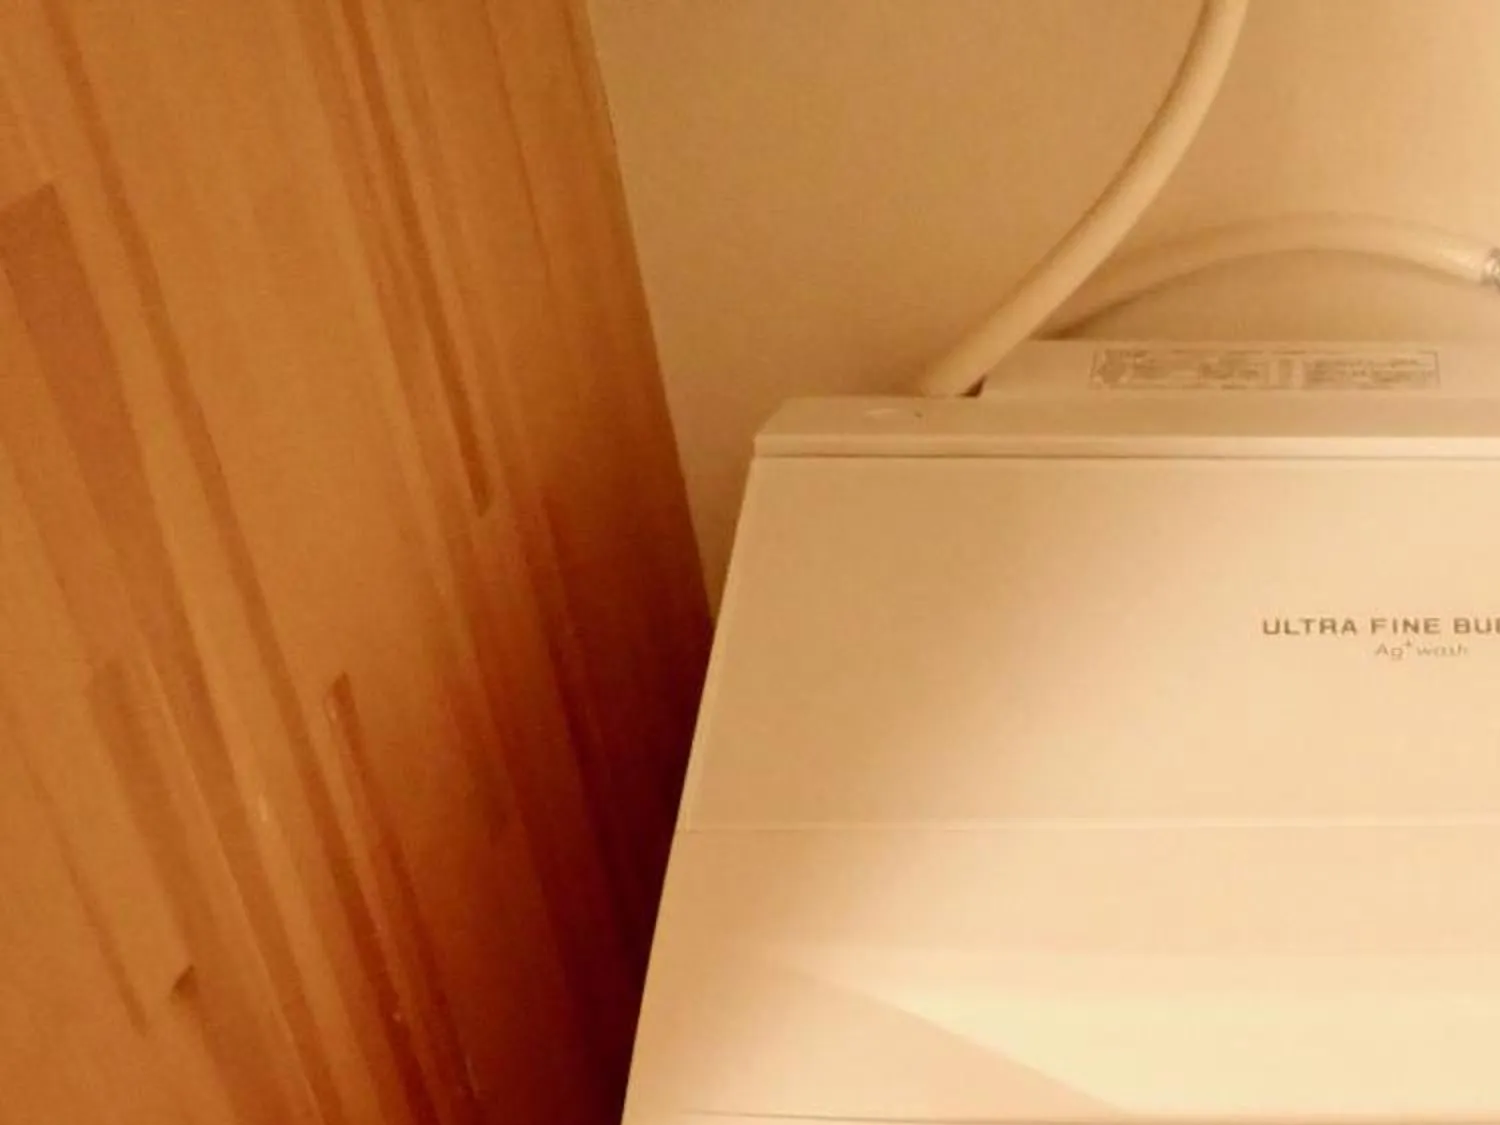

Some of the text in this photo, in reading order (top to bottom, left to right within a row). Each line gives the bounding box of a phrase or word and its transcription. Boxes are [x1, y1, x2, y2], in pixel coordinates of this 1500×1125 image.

[1262, 617, 1358, 636] ULTRA
[1370, 617, 1441, 636] FINE
[1416, 642, 1470, 658] wash
